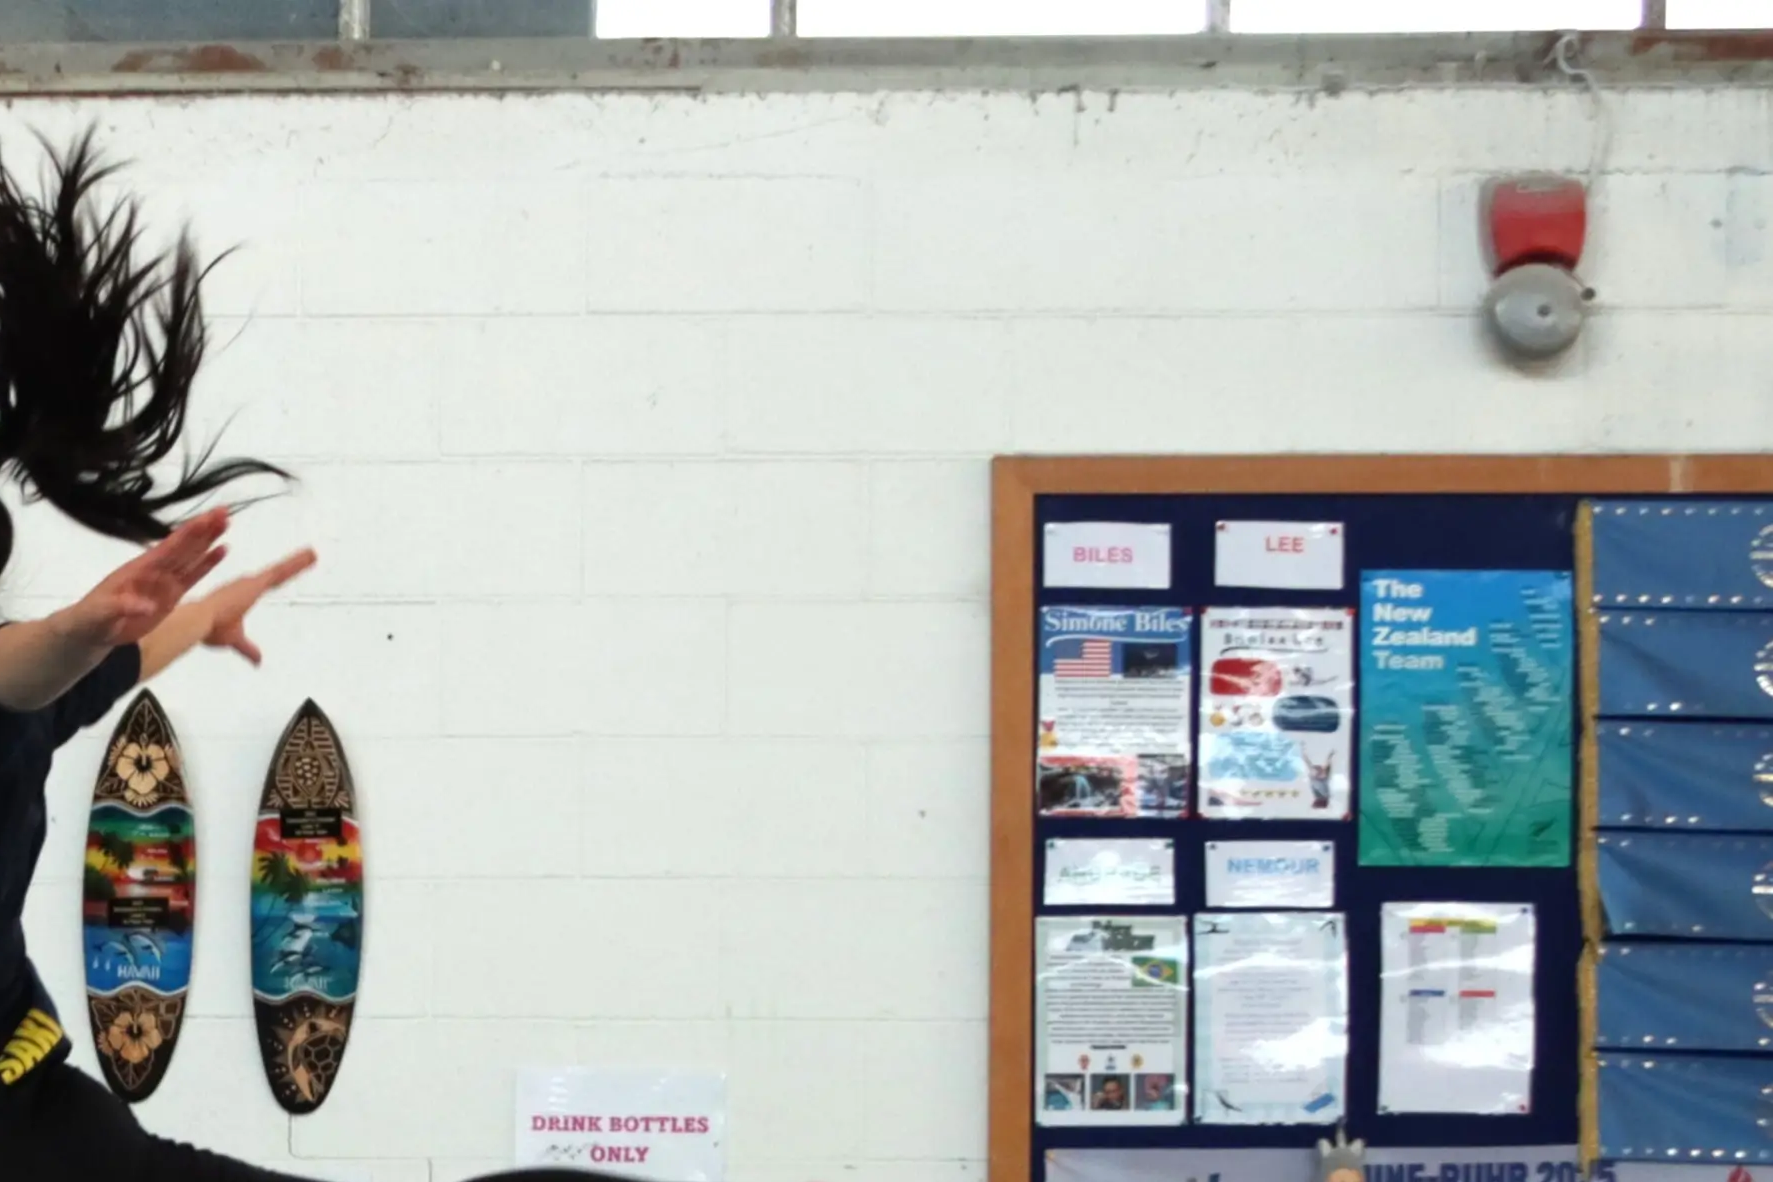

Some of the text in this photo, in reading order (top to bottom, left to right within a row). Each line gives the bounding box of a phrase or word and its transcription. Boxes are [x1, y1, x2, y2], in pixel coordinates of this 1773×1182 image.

[1265, 536, 1305, 553] LEE
[1073, 546, 1134, 563] BILES
[1372, 578, 1424, 598] The
[1372, 603, 1433, 622] New
[1044, 612, 1127, 633] Simone
[1134, 612, 1190, 633] Biles
[1372, 627, 1477, 646] Zealand
[1372, 650, 1444, 670] Team
[1227, 858, 1320, 875] NEMOUR
[531, 1115, 709, 1134] DRINK BOTTLES
[590, 1145, 649, 1163] ONLY
